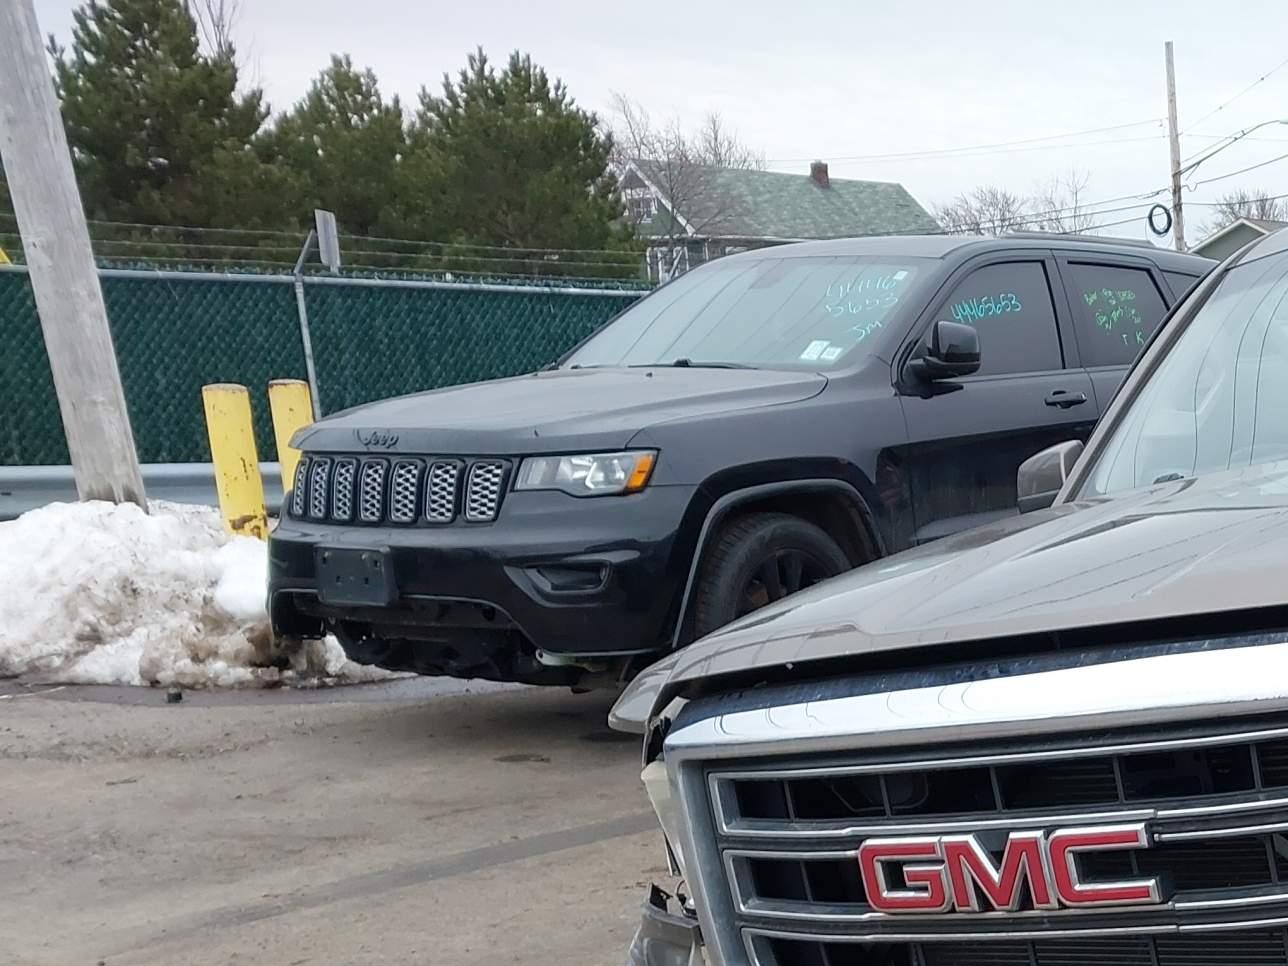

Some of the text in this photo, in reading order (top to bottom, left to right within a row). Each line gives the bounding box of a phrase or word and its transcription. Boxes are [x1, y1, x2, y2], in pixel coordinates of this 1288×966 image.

[950, 293, 1022, 323] 44465653
[361, 431, 400, 449] Jeep
[859, 823, 1162, 913] GMC
